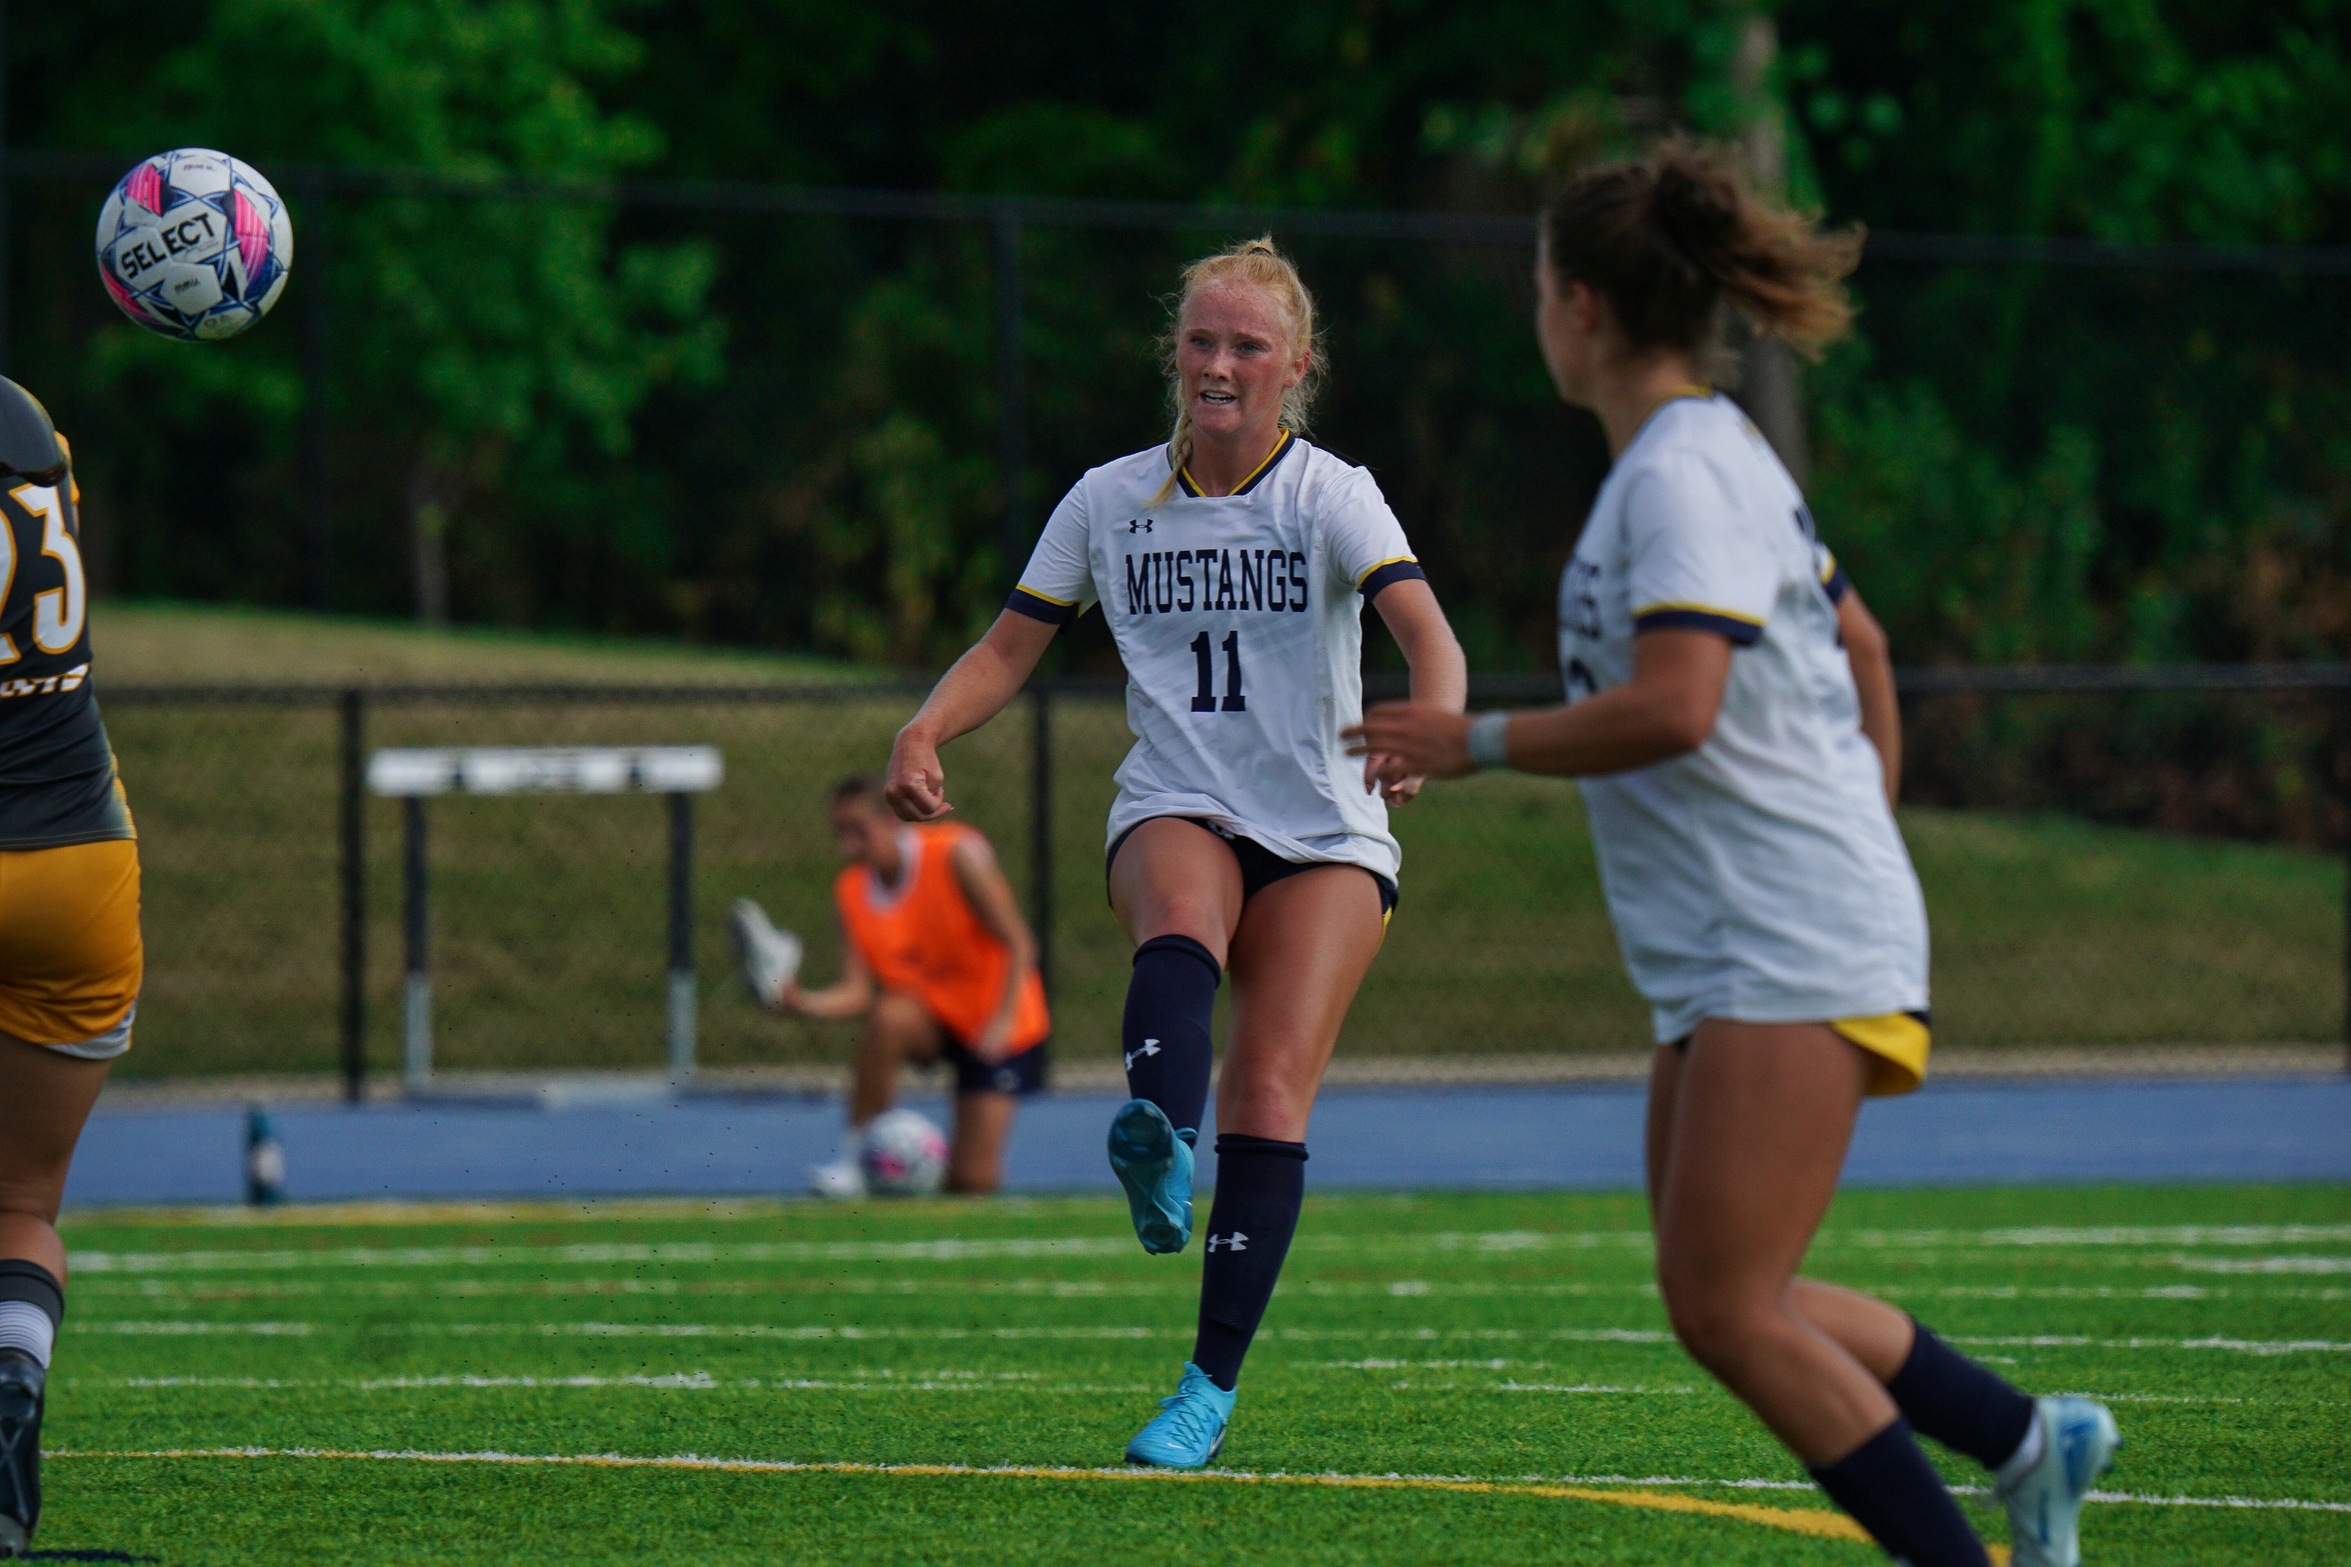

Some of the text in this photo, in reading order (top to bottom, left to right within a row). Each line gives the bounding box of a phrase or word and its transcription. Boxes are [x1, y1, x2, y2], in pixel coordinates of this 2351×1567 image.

[121, 213, 214, 279] SELECT
[1125, 548, 1308, 615] MUSTANGS
[1190, 630, 1246, 713] 11
